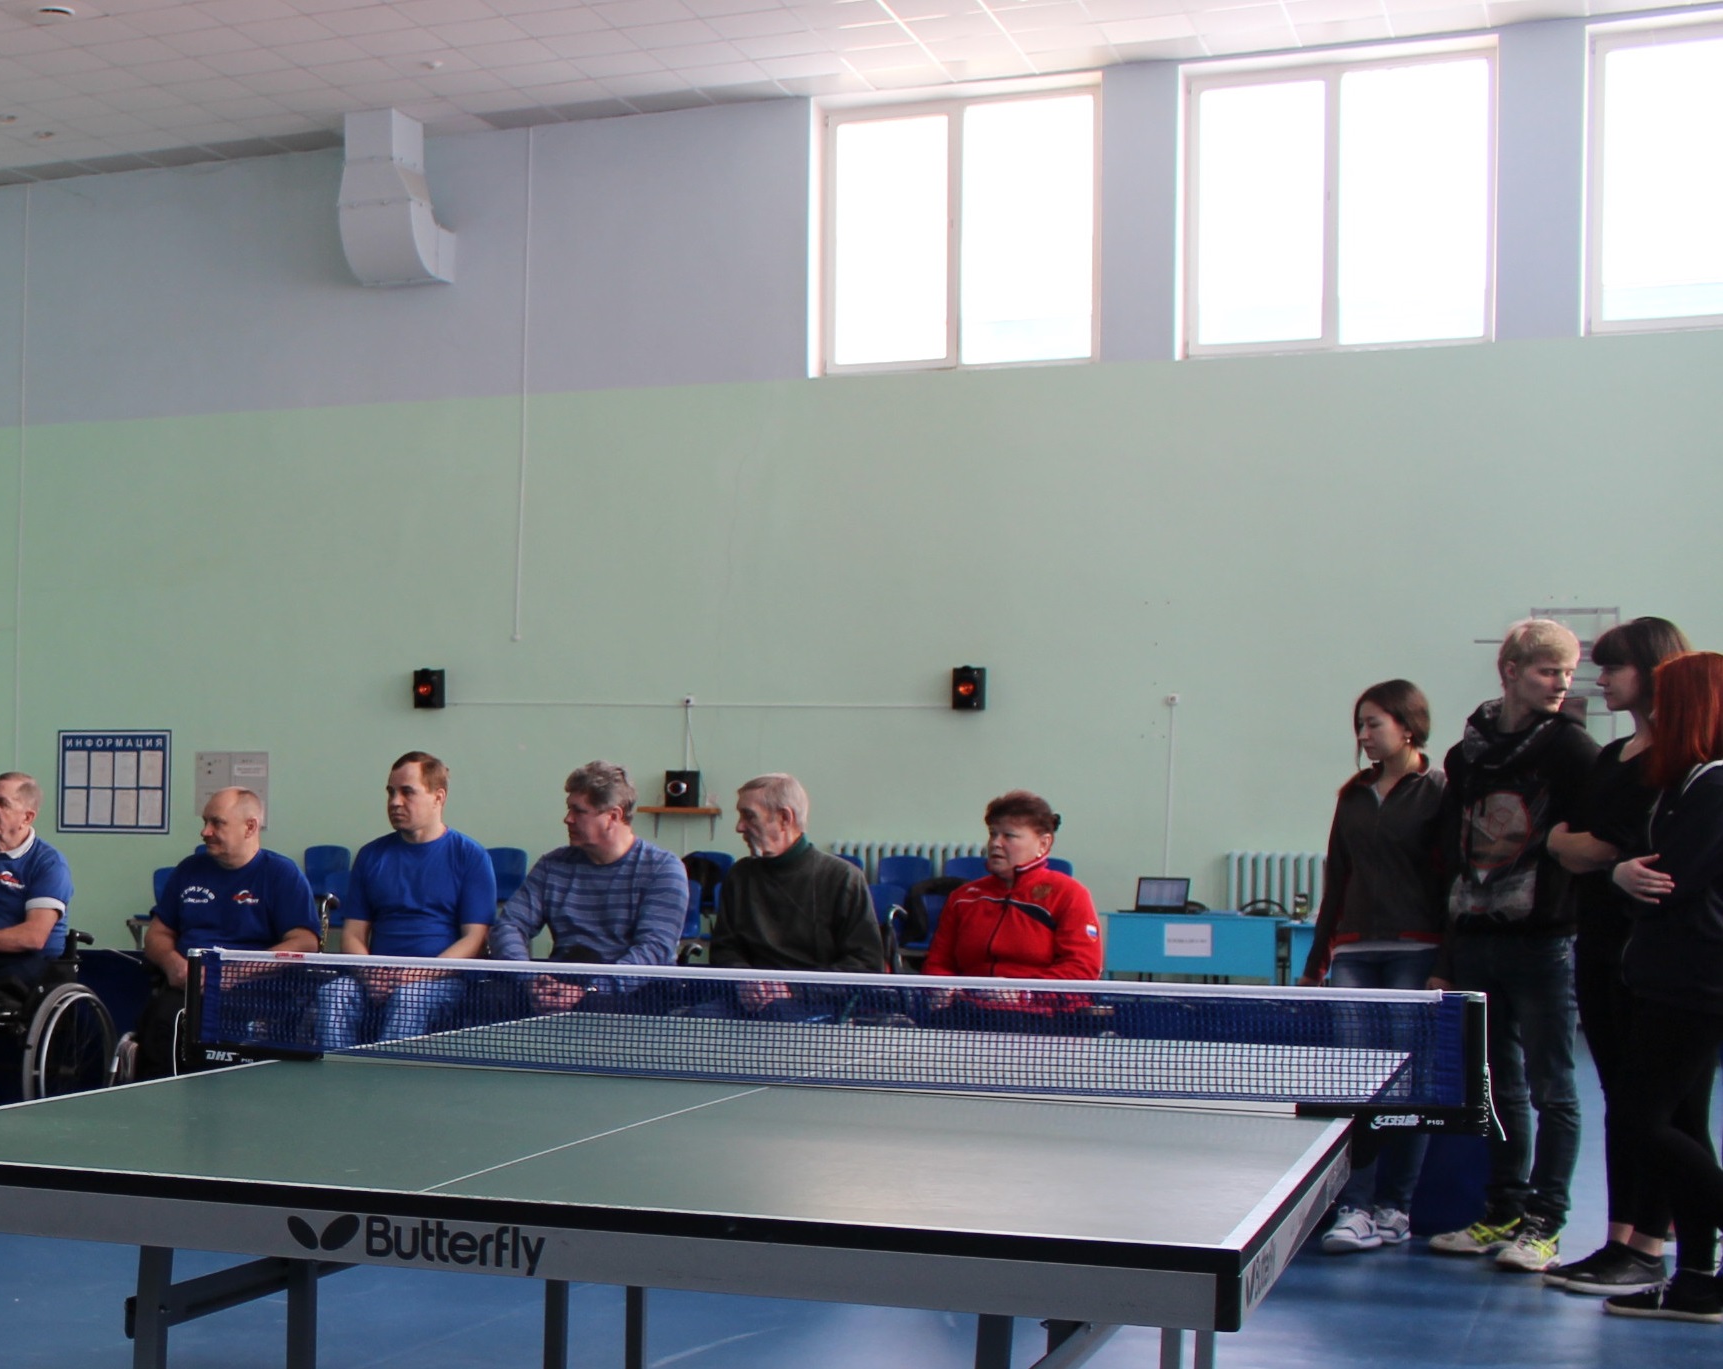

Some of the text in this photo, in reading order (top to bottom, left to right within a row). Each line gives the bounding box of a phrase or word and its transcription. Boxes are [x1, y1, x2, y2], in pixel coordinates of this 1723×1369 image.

[66, 738, 164, 748] ИНФОРМАЦИЯ
[206, 1050, 240, 1062] DHS
[365, 1215, 546, 1277] Butterfly
